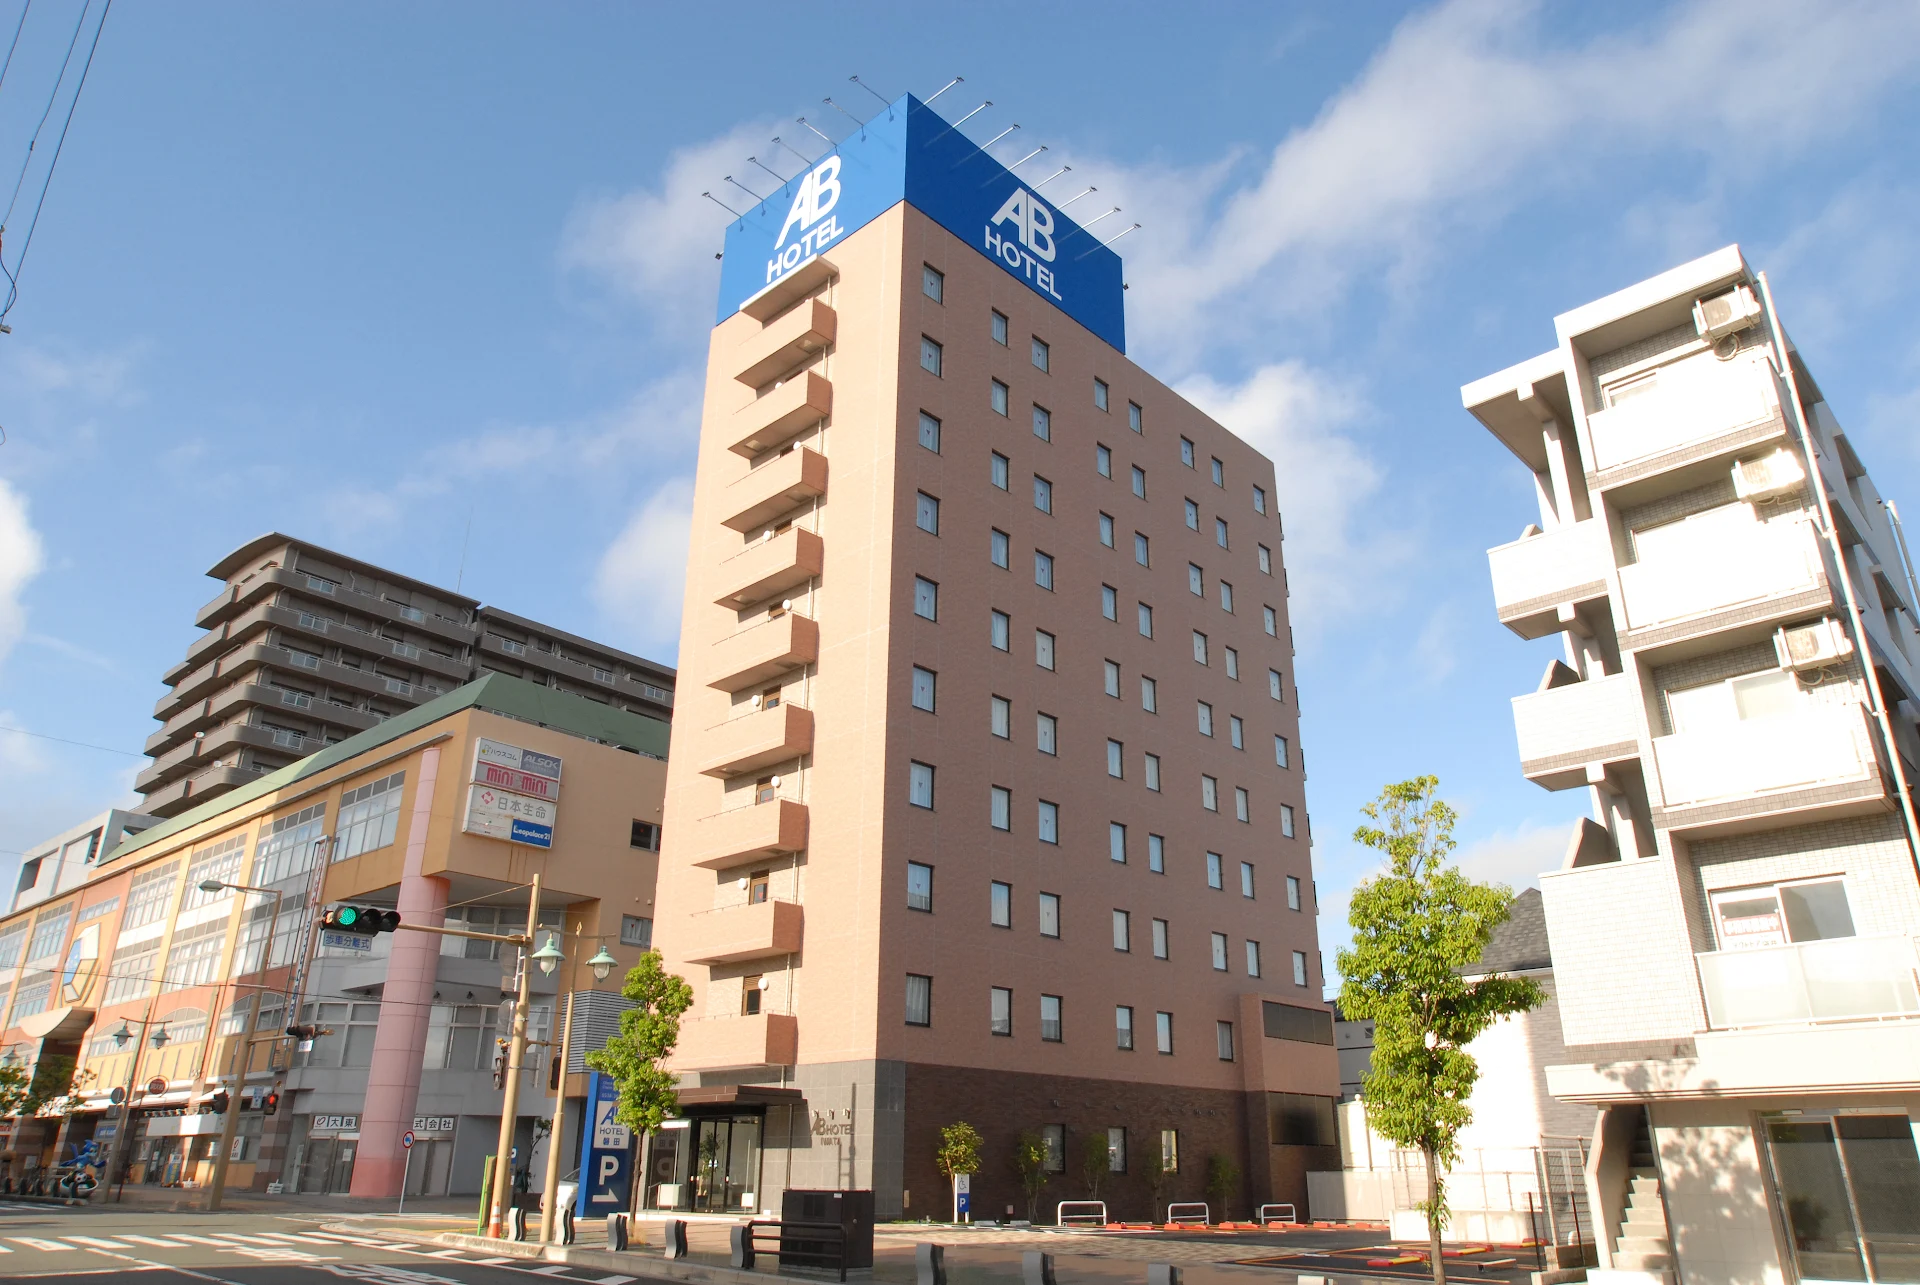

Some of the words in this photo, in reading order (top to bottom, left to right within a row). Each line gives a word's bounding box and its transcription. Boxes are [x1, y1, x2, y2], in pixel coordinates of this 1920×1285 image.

[775, 154, 842, 250] AB
[991, 187, 1057, 262] AB
[766, 215, 844, 284] HOTEL
[984, 225, 1062, 301] HOTEL
[491, 749, 517, 760] ハウスコム
[524, 754, 558, 770] ALSOK
[486, 767, 514, 786] mini
[522, 775, 548, 795] mini
[498, 796, 547, 819] 日本生命
[325, 934, 370, 950] 歩車分離式
[330, 1118, 354, 1127] 大東
[414, 1118, 452, 1129] 式会社
[600, 1127, 624, 1136] HOTEL
[599, 1155, 619, 1186] P
[960, 1197, 966, 1208] P
